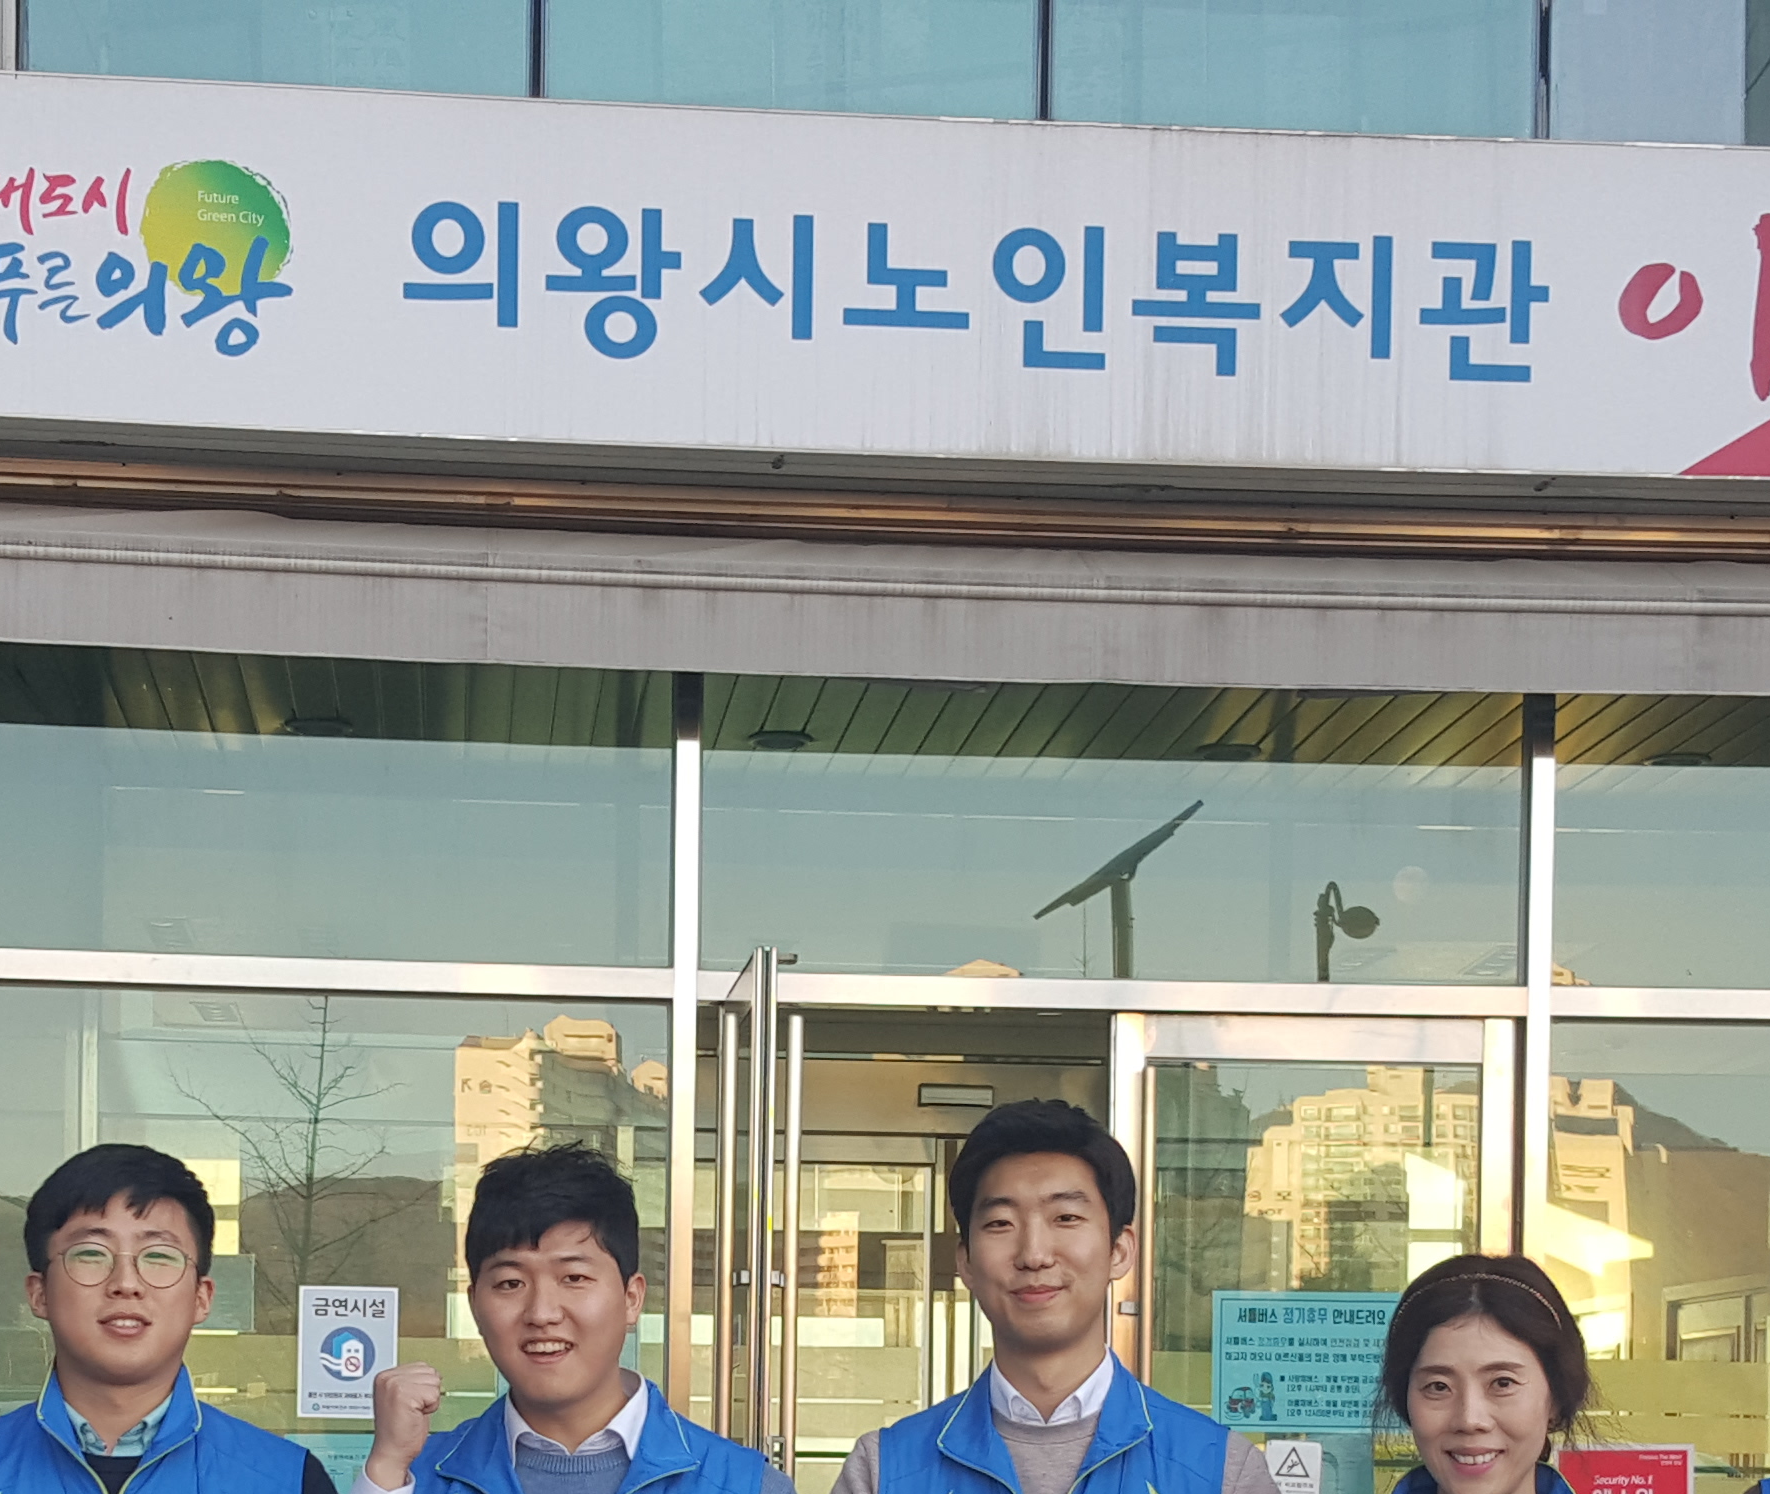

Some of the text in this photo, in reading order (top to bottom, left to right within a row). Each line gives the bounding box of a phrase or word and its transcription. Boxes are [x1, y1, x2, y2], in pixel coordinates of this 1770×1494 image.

[197, 190, 240, 205] Future
[197, 208, 265, 227] Green City
[401, 200, 1550, 382] 의왕시노인복지관
[312, 1297, 386, 1319] 금연시설
[1237, 1307, 1386, 1325] 셔틀버스 정기휴무 안내드려요
[1593, 1474, 1630, 1487] Security
